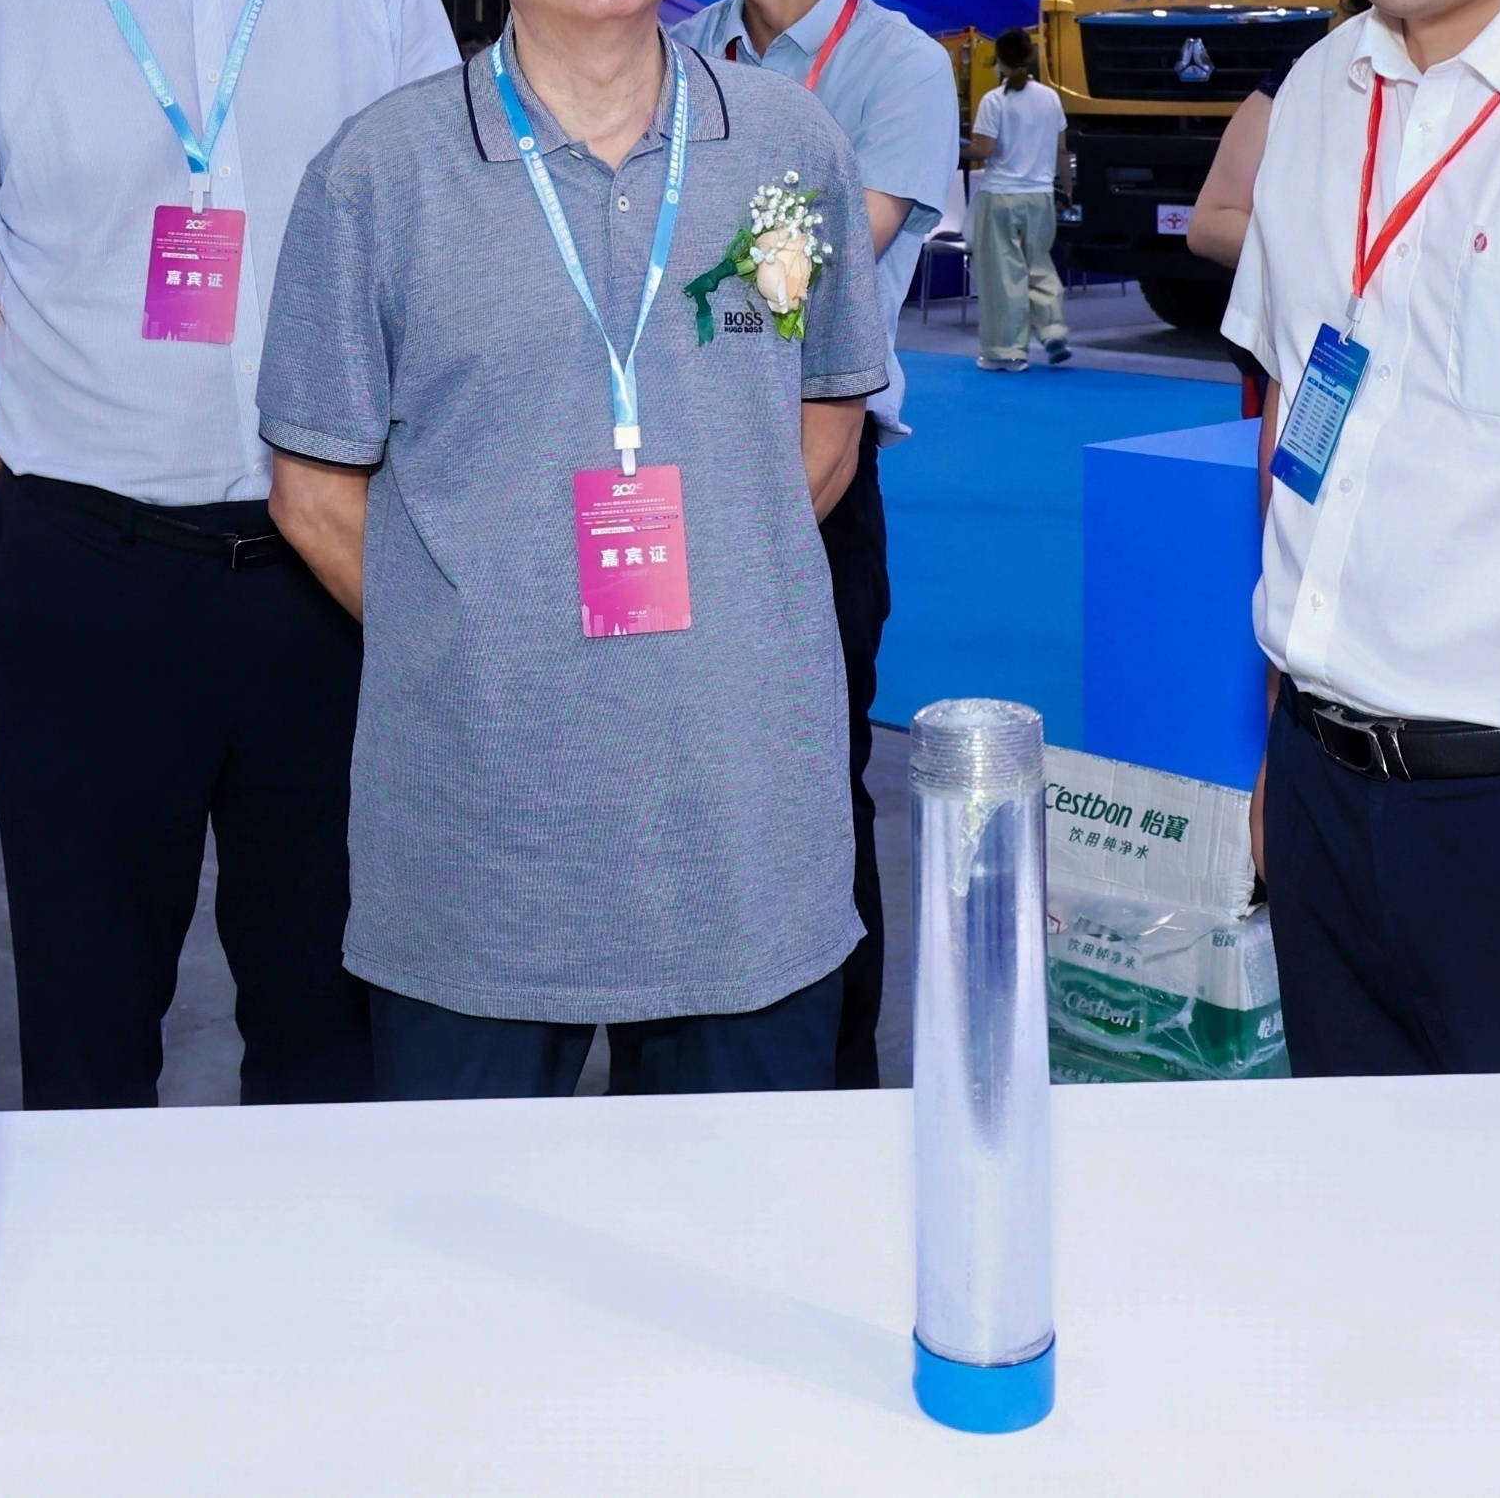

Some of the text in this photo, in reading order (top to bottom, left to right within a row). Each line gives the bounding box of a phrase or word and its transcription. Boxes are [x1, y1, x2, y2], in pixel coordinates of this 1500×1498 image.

[166, 270, 223, 287] 嘉宾证
[724, 311, 764, 326] BOSS
[601, 545, 668, 568] 嘉宾证
[1140, 809, 1189, 842] 怡寶
[1068, 826, 1149, 859] 饮用纯净水
